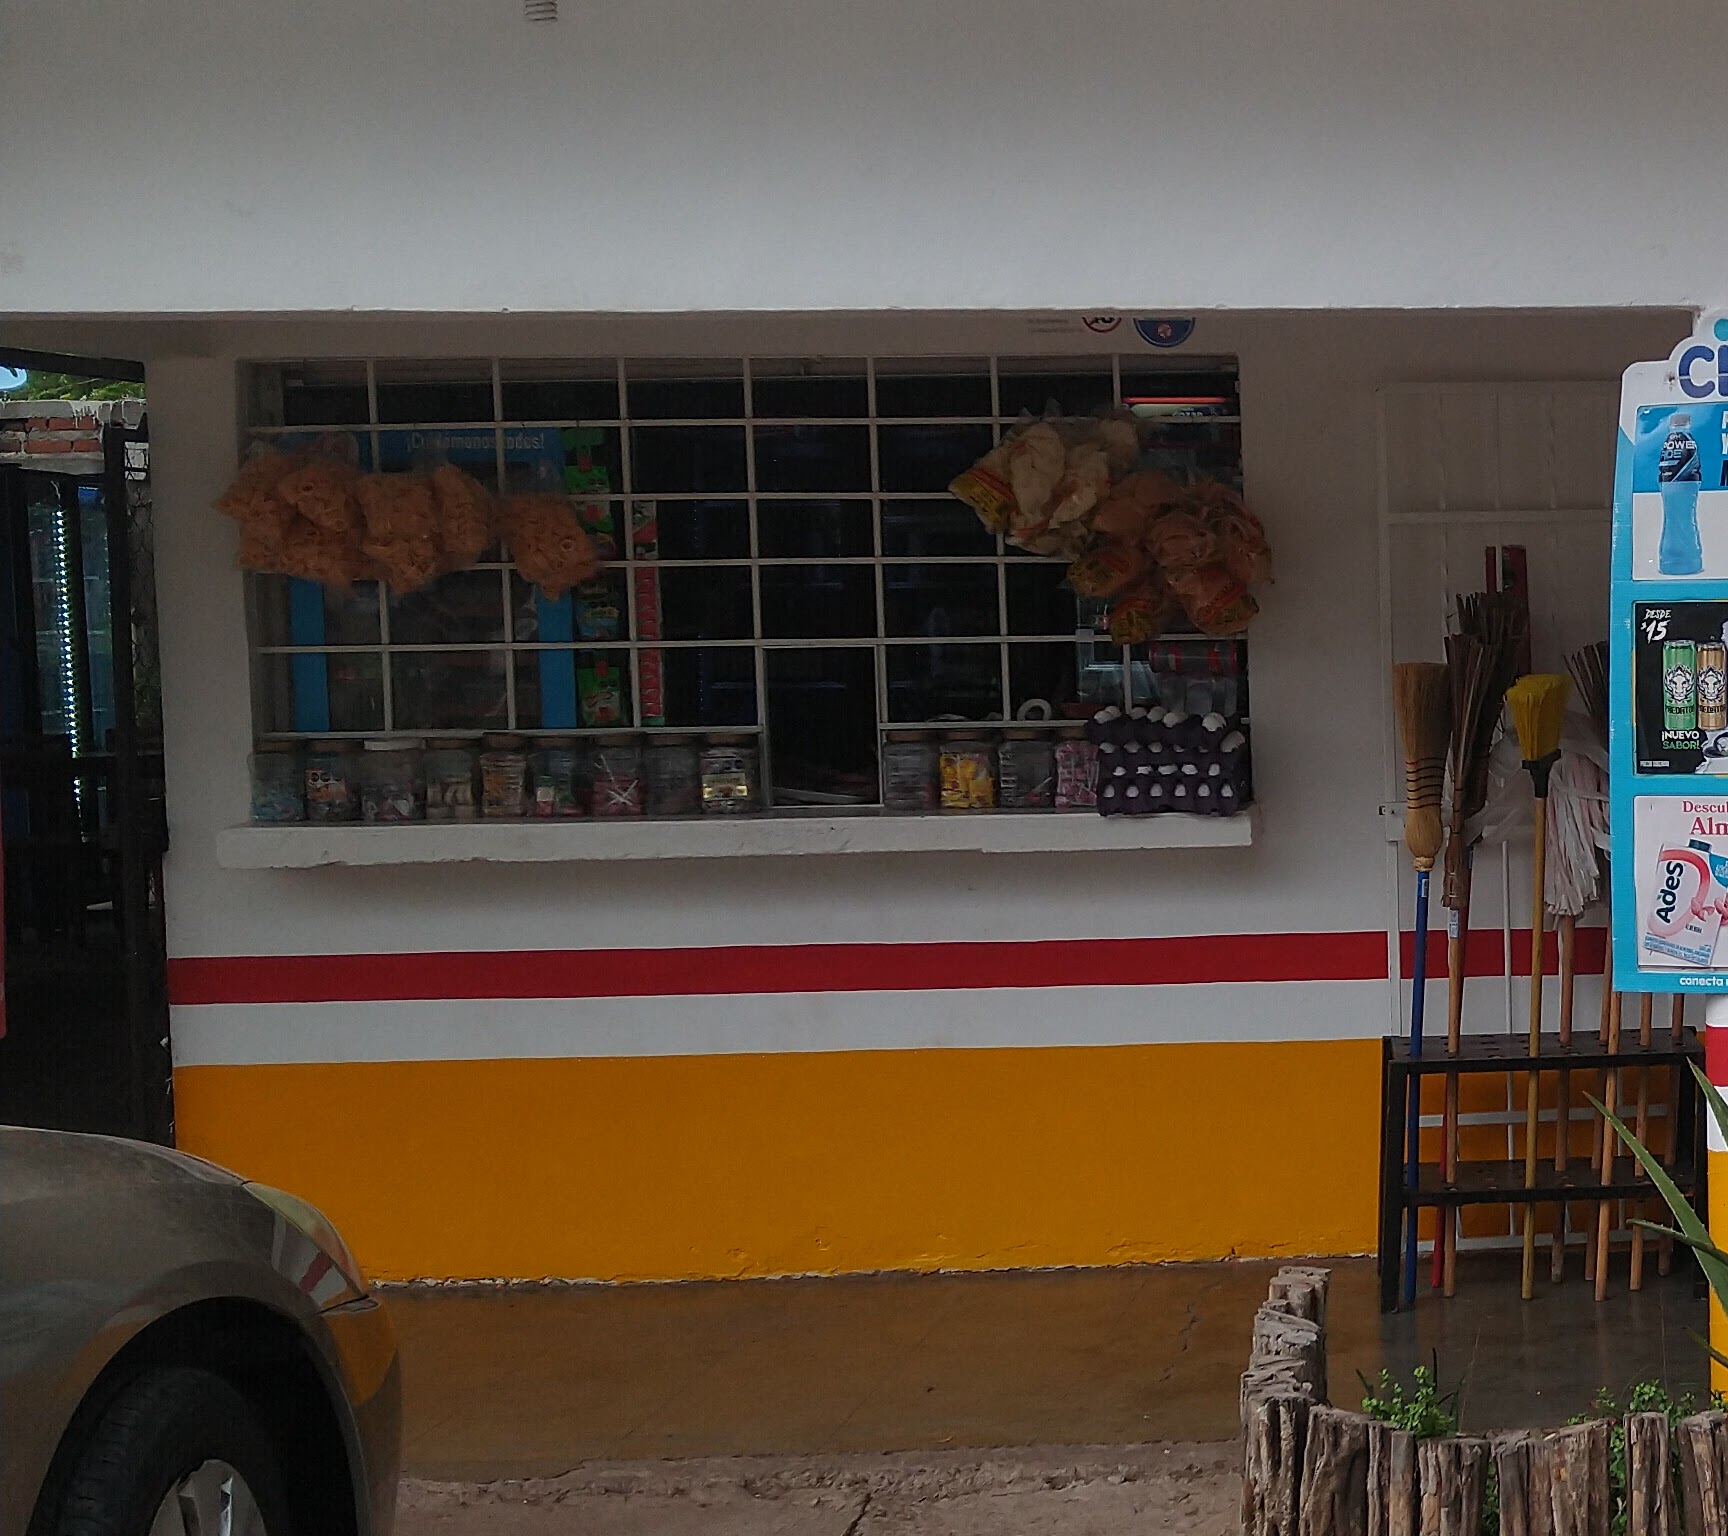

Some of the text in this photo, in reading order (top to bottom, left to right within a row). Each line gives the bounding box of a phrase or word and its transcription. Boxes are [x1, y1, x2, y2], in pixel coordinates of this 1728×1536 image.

[1643, 608, 1672, 620] DESDE
[1661, 730, 1700, 741] ¡NUEVO
[1662, 740, 1701, 750] SABOR!
[1679, 976, 1724, 985] conecta
